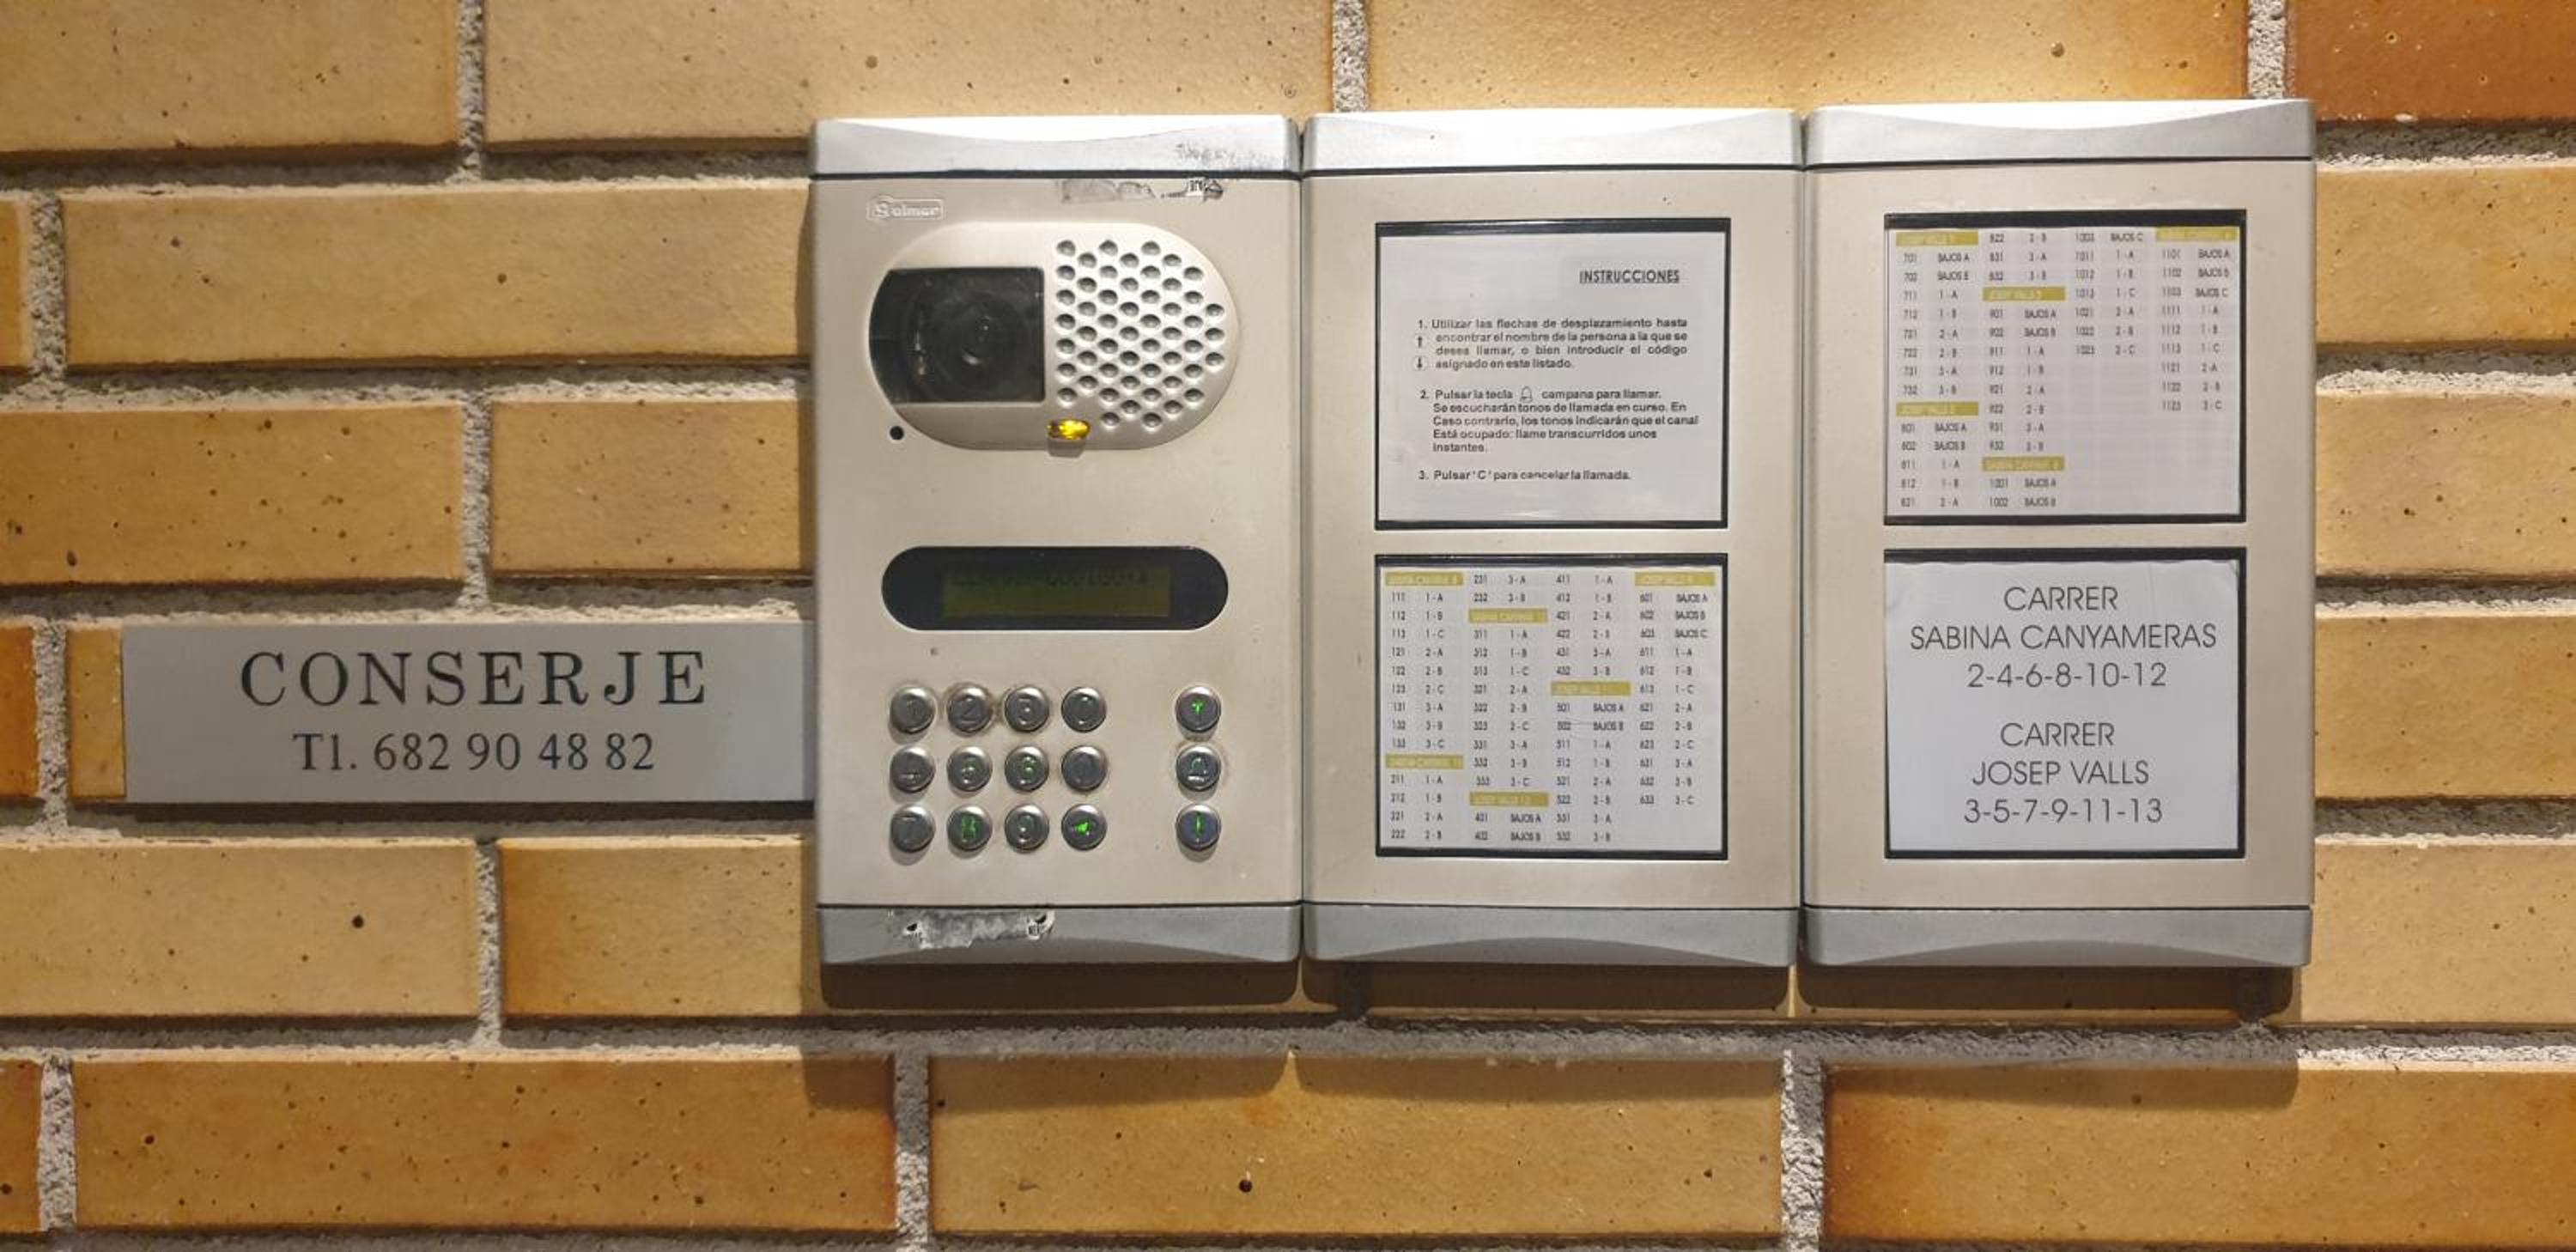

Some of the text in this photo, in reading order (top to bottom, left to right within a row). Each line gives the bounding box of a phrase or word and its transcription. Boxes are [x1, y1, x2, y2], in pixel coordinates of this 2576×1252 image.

[1579, 270, 1680, 283] INSTRUCCIONES
[1431, 319, 1472, 328] Utilizar
[1476, 319, 1492, 328] las
[1497, 319, 1539, 328] flechas
[1542, 319, 1556, 328] de
[1561, 319, 1652, 330] desplazamiento
[1656, 318, 1687, 327] hasta
[1436, 333, 1491, 342] encontrar
[1493, 331, 1503, 342] el
[1506, 331, 1549, 342] nombre
[1552, 331, 1565, 342] de
[1568, 331, 1577, 342] la
[1580, 333, 1626, 343] persona
[1638, 331, 1647, 342] la
[1650, 333, 1671, 343] que
[1436, 346, 1469, 356] desea
[1476, 346, 1515, 356] llamar,
[1535, 345, 1559, 354] bien
[1631, 345, 1640, 354] el
[1647, 345, 1687, 356] código
[1436, 359, 1488, 371] asignado
[1506, 359, 1530, 368] este
[1533, 359, 1575, 368] listado.
[1435, 390, 1472, 398] Pulsar
[1473, 390, 1484, 398] la
[1485, 390, 1513, 398] tecla
[1541, 391, 1594, 400] campana
[1596, 391, 1621, 400] para
[1623, 389, 1662, 398] llamar.
[1432, 404, 1448, 412] Se
[1518, 404, 1551, 412] tonos
[1552, 404, 1566, 412] de
[1570, 404, 1613, 412] llamada
[1670, 402, 1686, 411] En
[1432, 416, 1461, 426] Caso
[1522, 416, 1539, 425] los
[1540, 416, 1573, 425] tonos
[1631, 417, 1652, 426] que
[1656, 416, 1666, 424] el
[1432, 429, 1457, 438] Está
[1516, 429, 1546, 438] llame
[1548, 429, 1625, 438] transcurridos
[1434, 471, 1470, 479] Pulsar
[1493, 472, 1518, 481] para
[1520, 471, 1570, 479] cancelar
[1571, 471, 1581, 479] la
[2003, 586, 2118, 611] CARRER
[1911, 623, 2217, 650] SABINA CANYAMERAS
[240, 650, 706, 707] CONSERJE
[1967, 662, 2166, 687] 2-4-6-8-10-12
[2000, 723, 2115, 746] CARRER
[373, 732, 451, 770] 682
[466, 732, 521, 770] 90
[538, 732, 588, 770] 48
[605, 732, 655, 770] 82
[1972, 761, 2149, 785] JOSEP VALLS
[1964, 799, 2163, 824] 3-5-7-9-11-13
